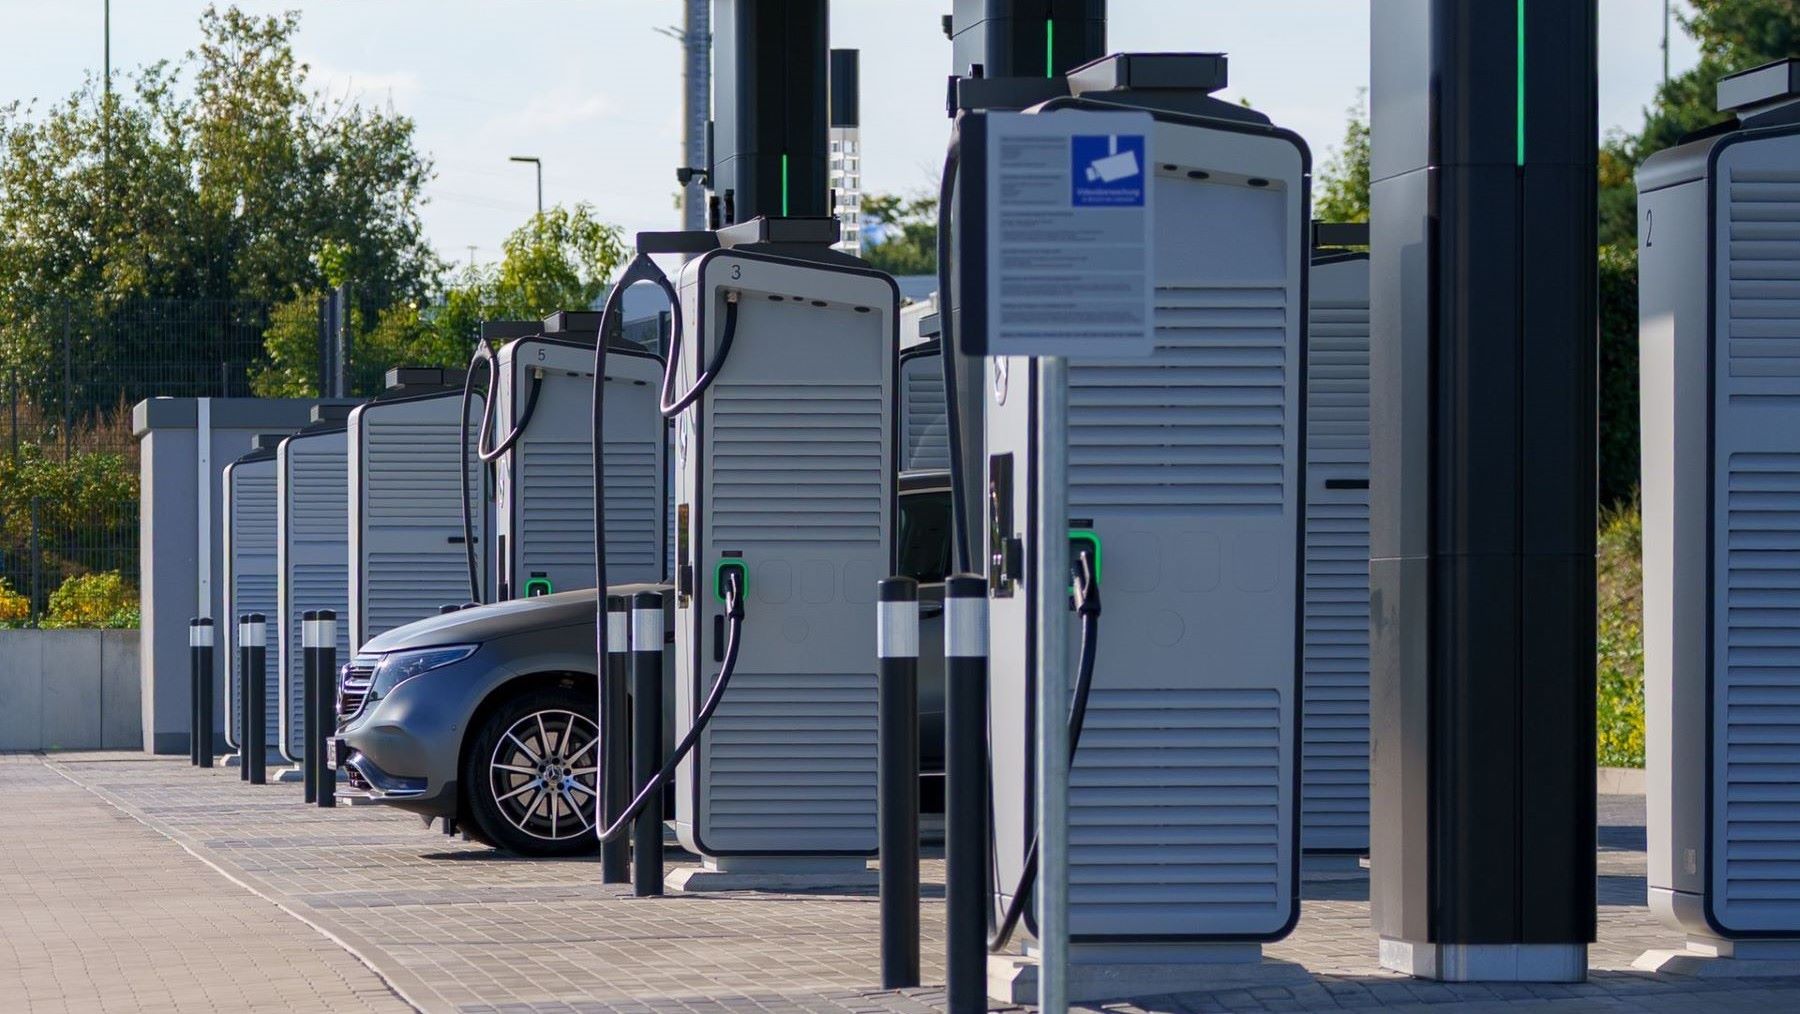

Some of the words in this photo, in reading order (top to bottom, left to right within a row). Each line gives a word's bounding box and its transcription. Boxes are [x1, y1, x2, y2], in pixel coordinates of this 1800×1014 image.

[1646, 209, 1652, 247] 2
[731, 264, 741, 280] 3
[537, 348, 546, 361] 5
